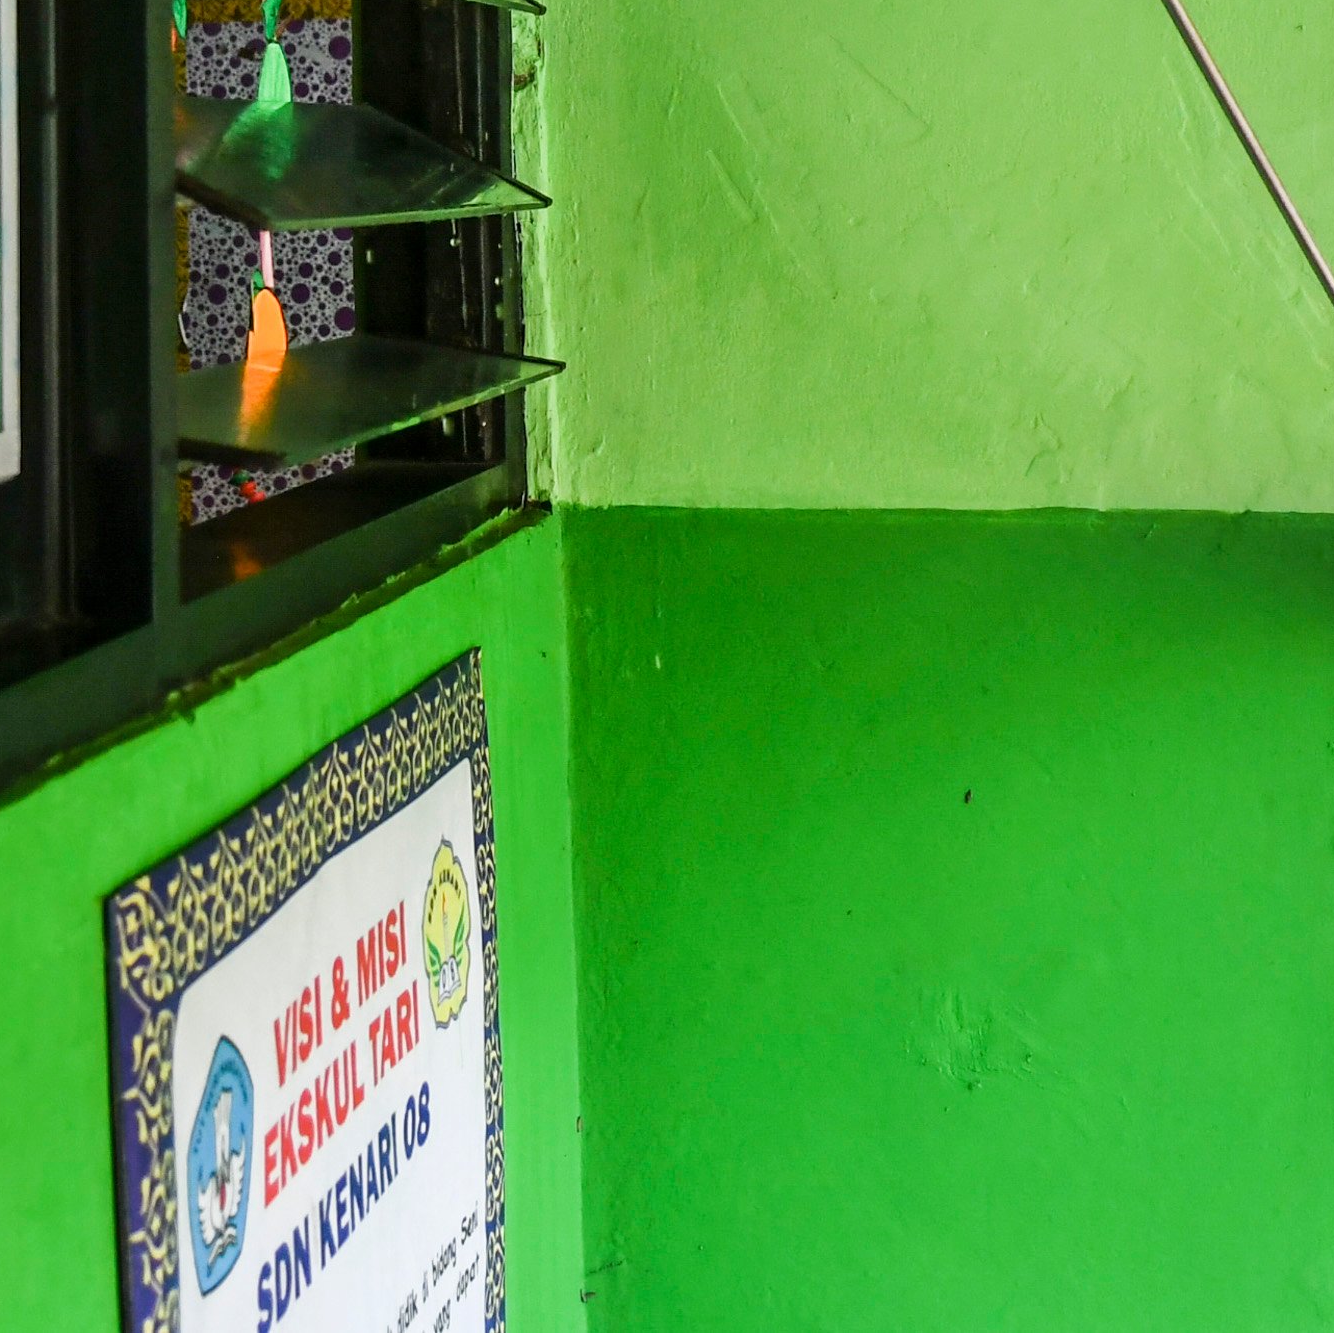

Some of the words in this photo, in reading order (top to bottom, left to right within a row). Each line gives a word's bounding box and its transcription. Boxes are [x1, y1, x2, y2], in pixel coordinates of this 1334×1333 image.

[264, 1039, 365, 1209] EKSKUL
[369, 979, 419, 1087] TARI
[274, 974, 322, 1088] VISI
[331, 955, 350, 1030] &
[357, 900, 407, 1008] MISI
[257, 1214, 312, 1333] SDN
[319, 1112, 398, 1270] KENARI
[404, 1081, 430, 1160] 08
[432, 1236, 456, 1288] bidang
[461, 1199, 478, 1246] Seni
